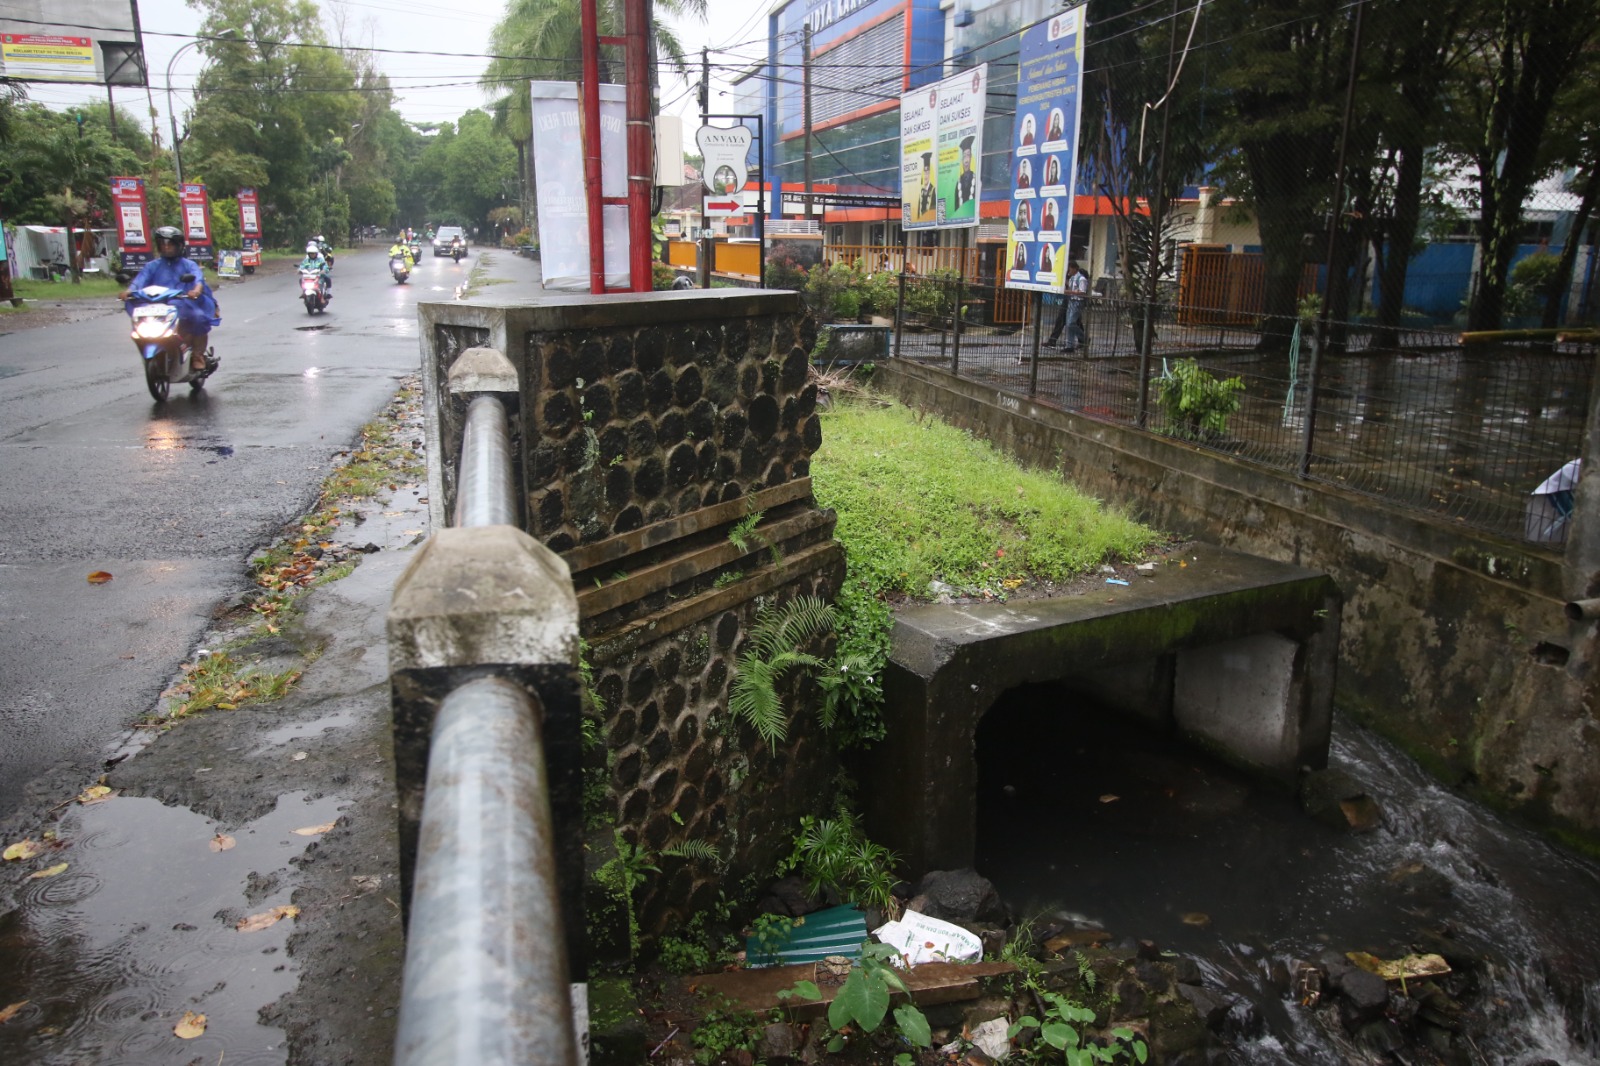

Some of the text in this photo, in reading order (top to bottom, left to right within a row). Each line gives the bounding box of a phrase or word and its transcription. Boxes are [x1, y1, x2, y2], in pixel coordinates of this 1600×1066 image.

[940, 93, 964, 109] SELAMAT
[904, 107, 924, 121] SELAMAT
[940, 107, 971, 125] DAN SUKSES
[904, 127, 913, 136] DAN
[913, 120, 931, 133] SUKSES
[704, 135, 745, 143] ANVAYA
